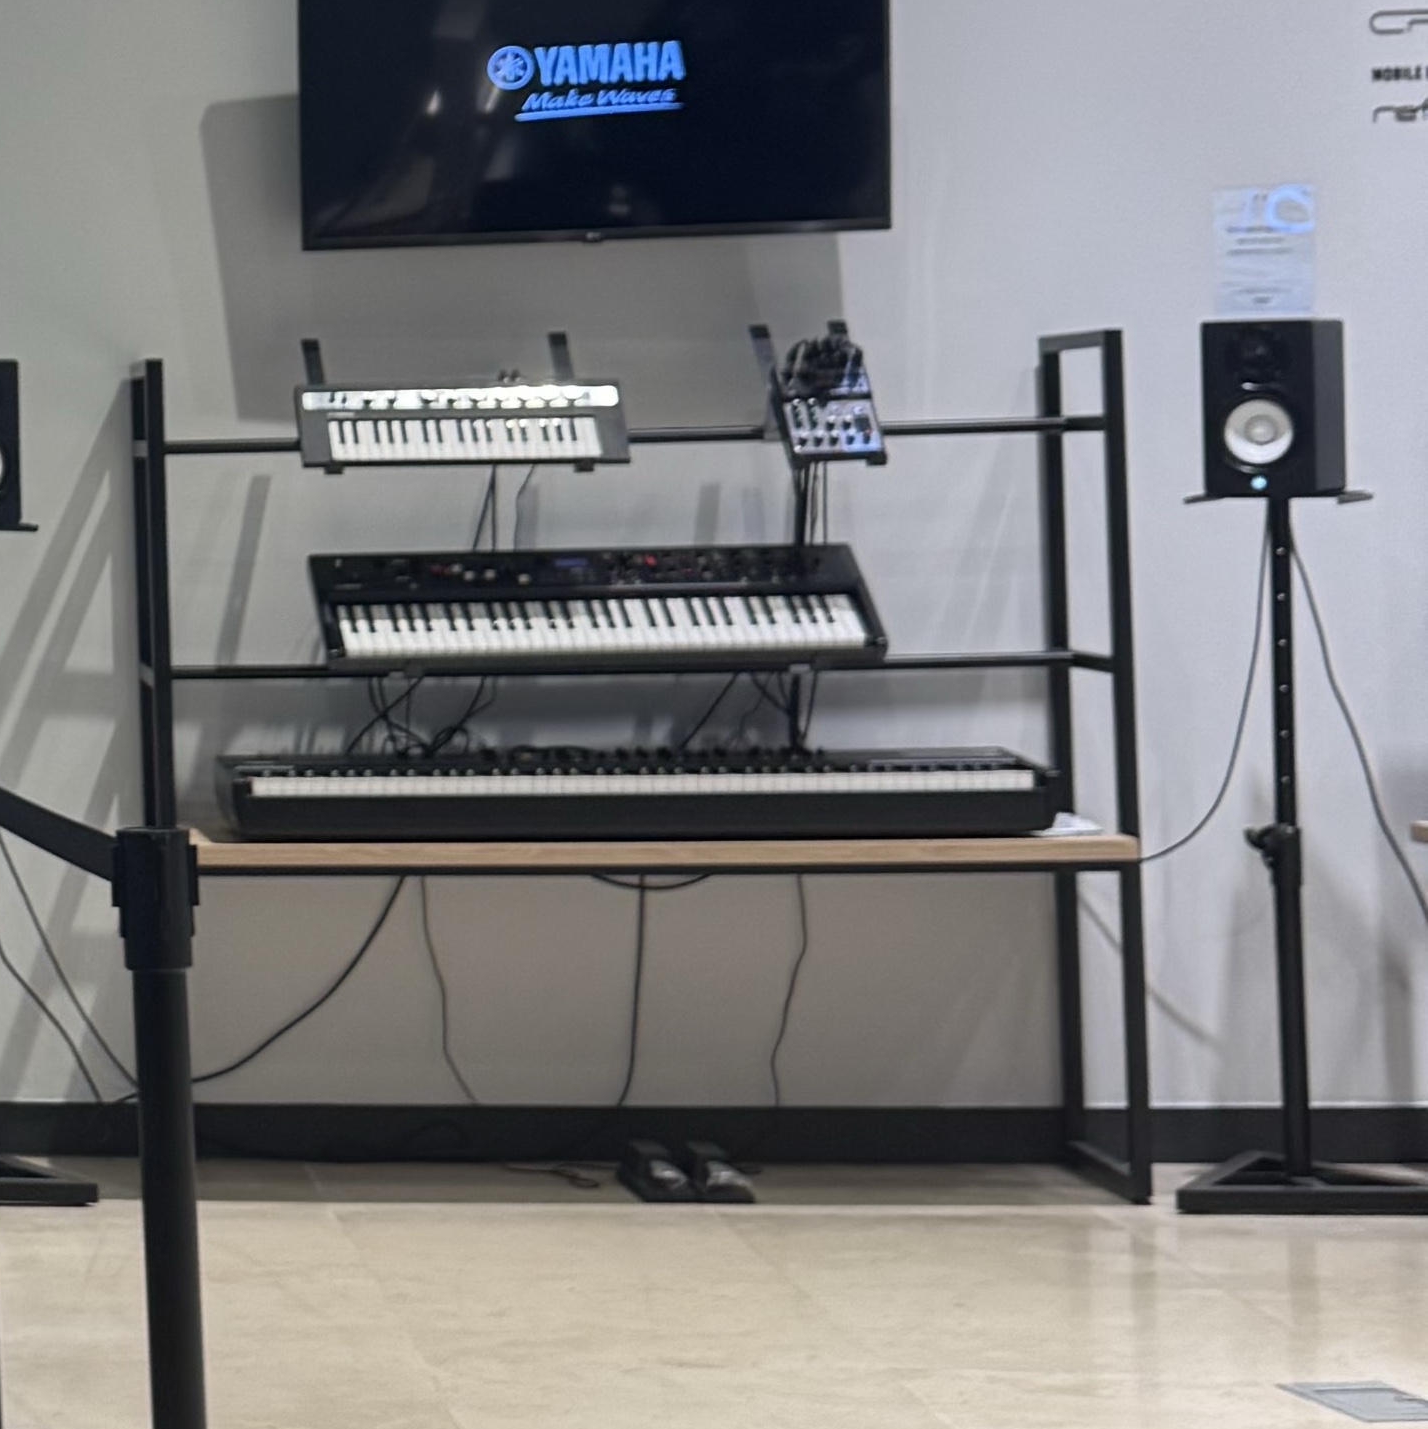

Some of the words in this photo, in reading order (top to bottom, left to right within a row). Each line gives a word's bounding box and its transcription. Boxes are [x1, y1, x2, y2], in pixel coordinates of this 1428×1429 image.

[534, 40, 686, 86] YAMAHA
[521, 89, 594, 111] Make
[596, 88, 677, 106] Waves
